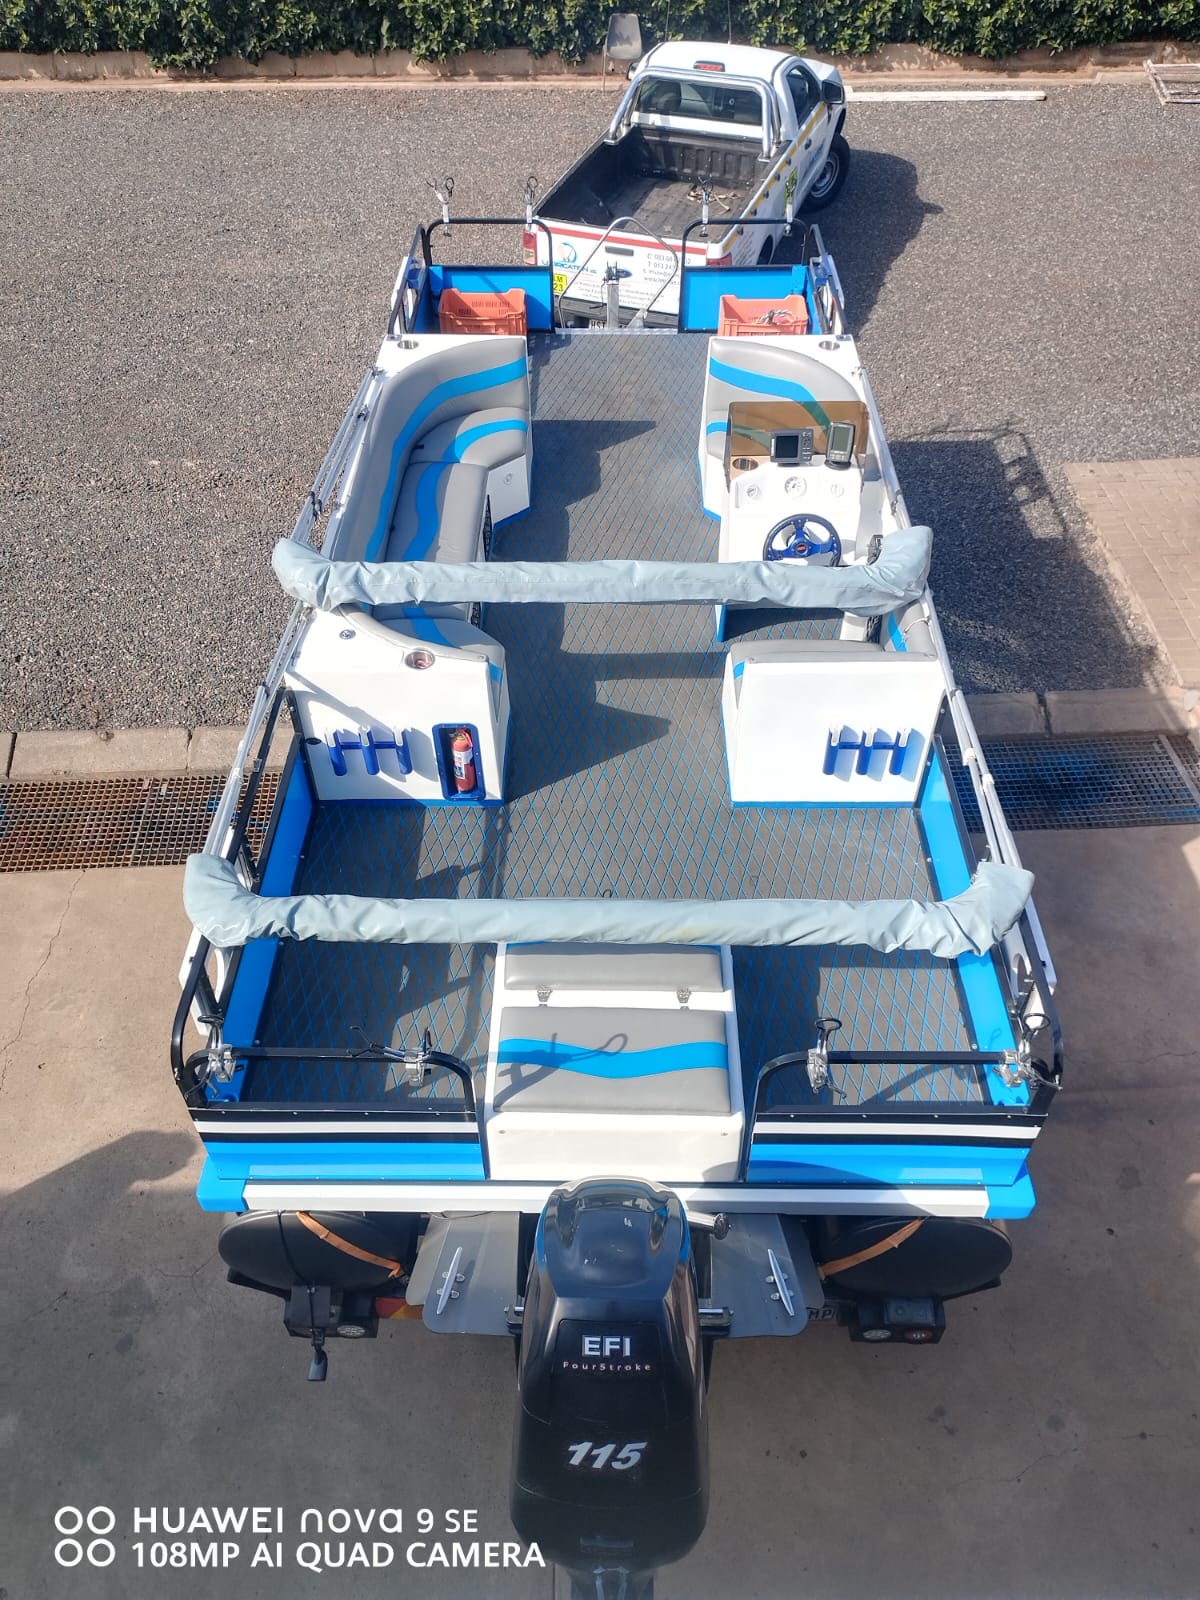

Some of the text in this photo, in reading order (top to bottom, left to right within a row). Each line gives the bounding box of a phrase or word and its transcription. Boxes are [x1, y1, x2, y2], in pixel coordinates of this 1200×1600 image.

[582, 1336, 631, 1357] EFI
[563, 1360, 652, 1372] FourStroke
[567, 1441, 649, 1471] 115
